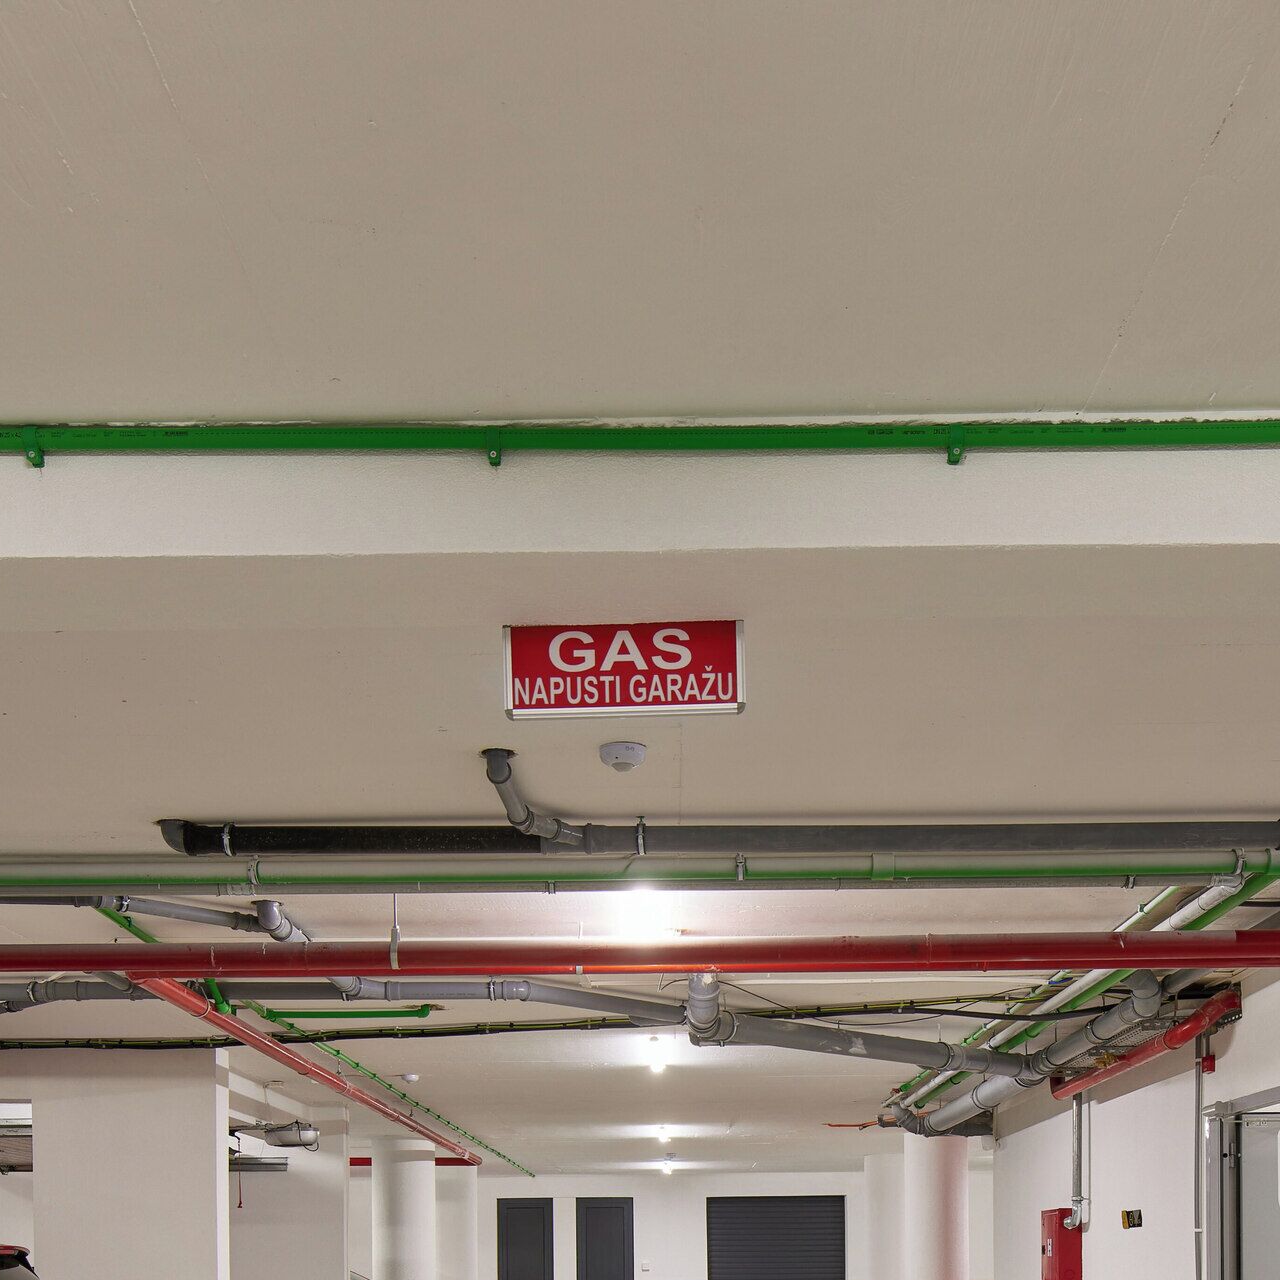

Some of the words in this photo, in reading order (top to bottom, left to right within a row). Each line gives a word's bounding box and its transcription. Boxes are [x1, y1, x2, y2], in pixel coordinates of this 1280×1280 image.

[548, 628, 692, 672] GAS
[514, 675, 620, 705] NAPUSTI
[629, 665, 733, 703] GARAŽU
